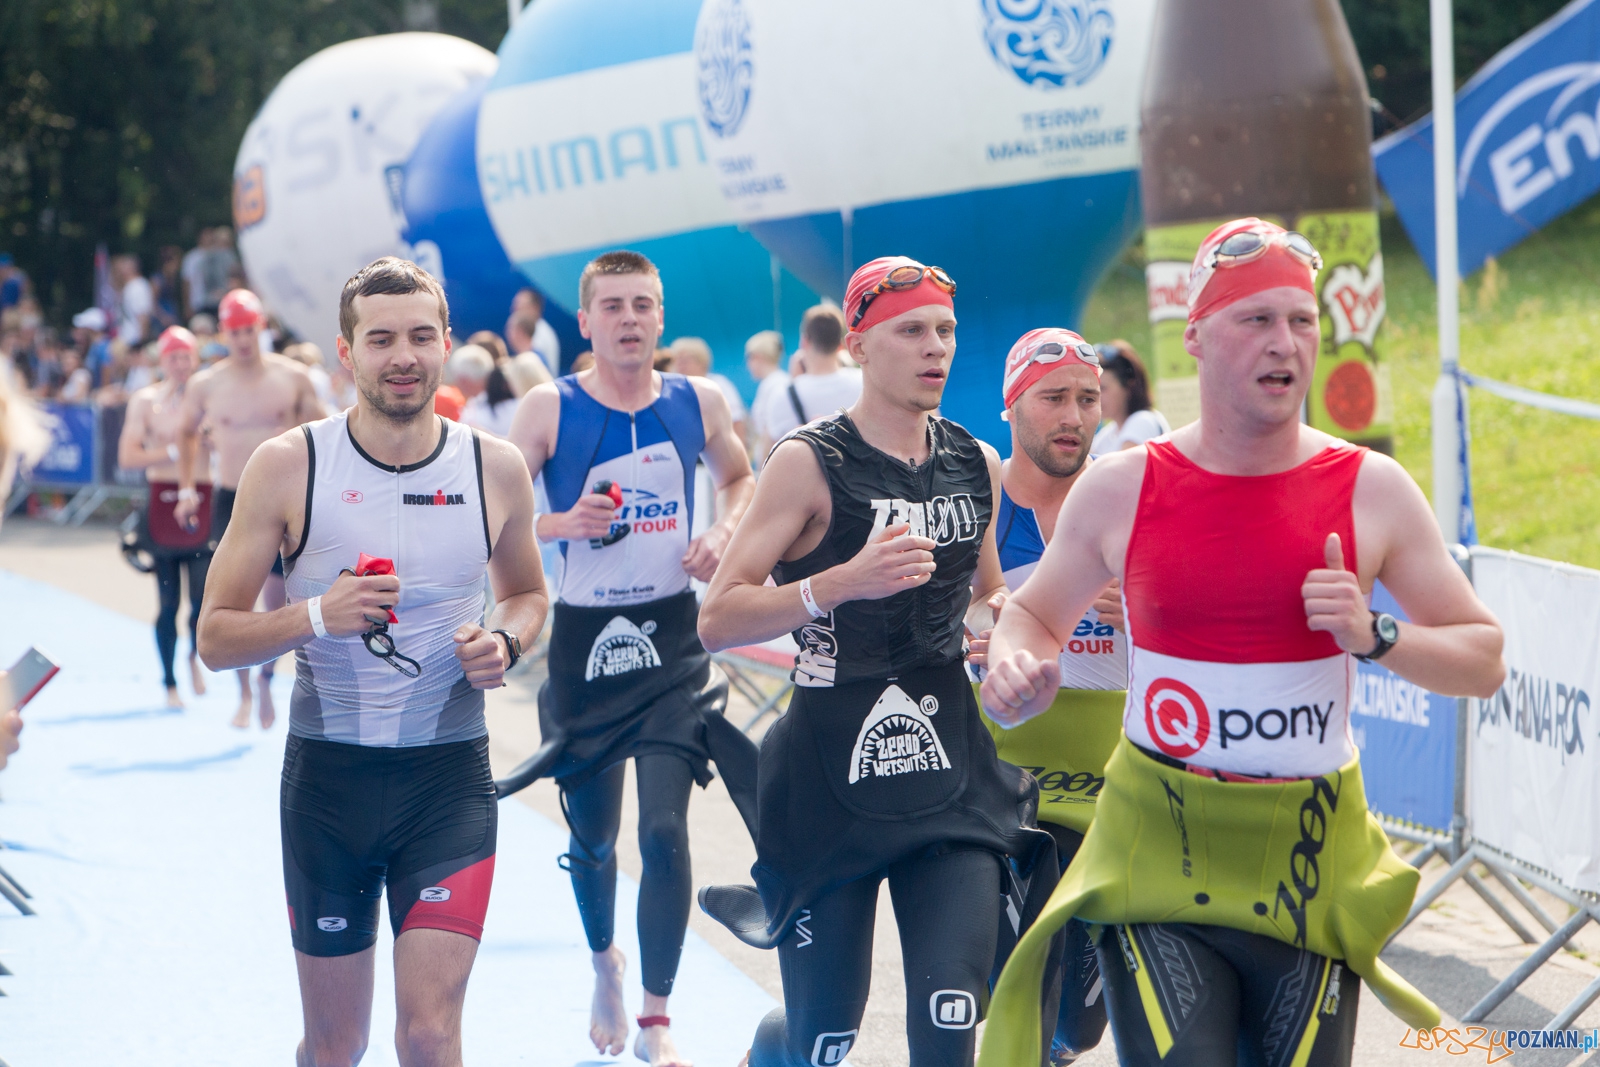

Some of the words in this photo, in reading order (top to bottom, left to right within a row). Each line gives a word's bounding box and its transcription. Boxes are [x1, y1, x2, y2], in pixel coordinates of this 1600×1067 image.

[1489, 98, 1600, 214] En
[620, 500, 679, 520] nea
[1063, 639, 1115, 655] OUR
[1066, 796, 1098, 804] FORC
